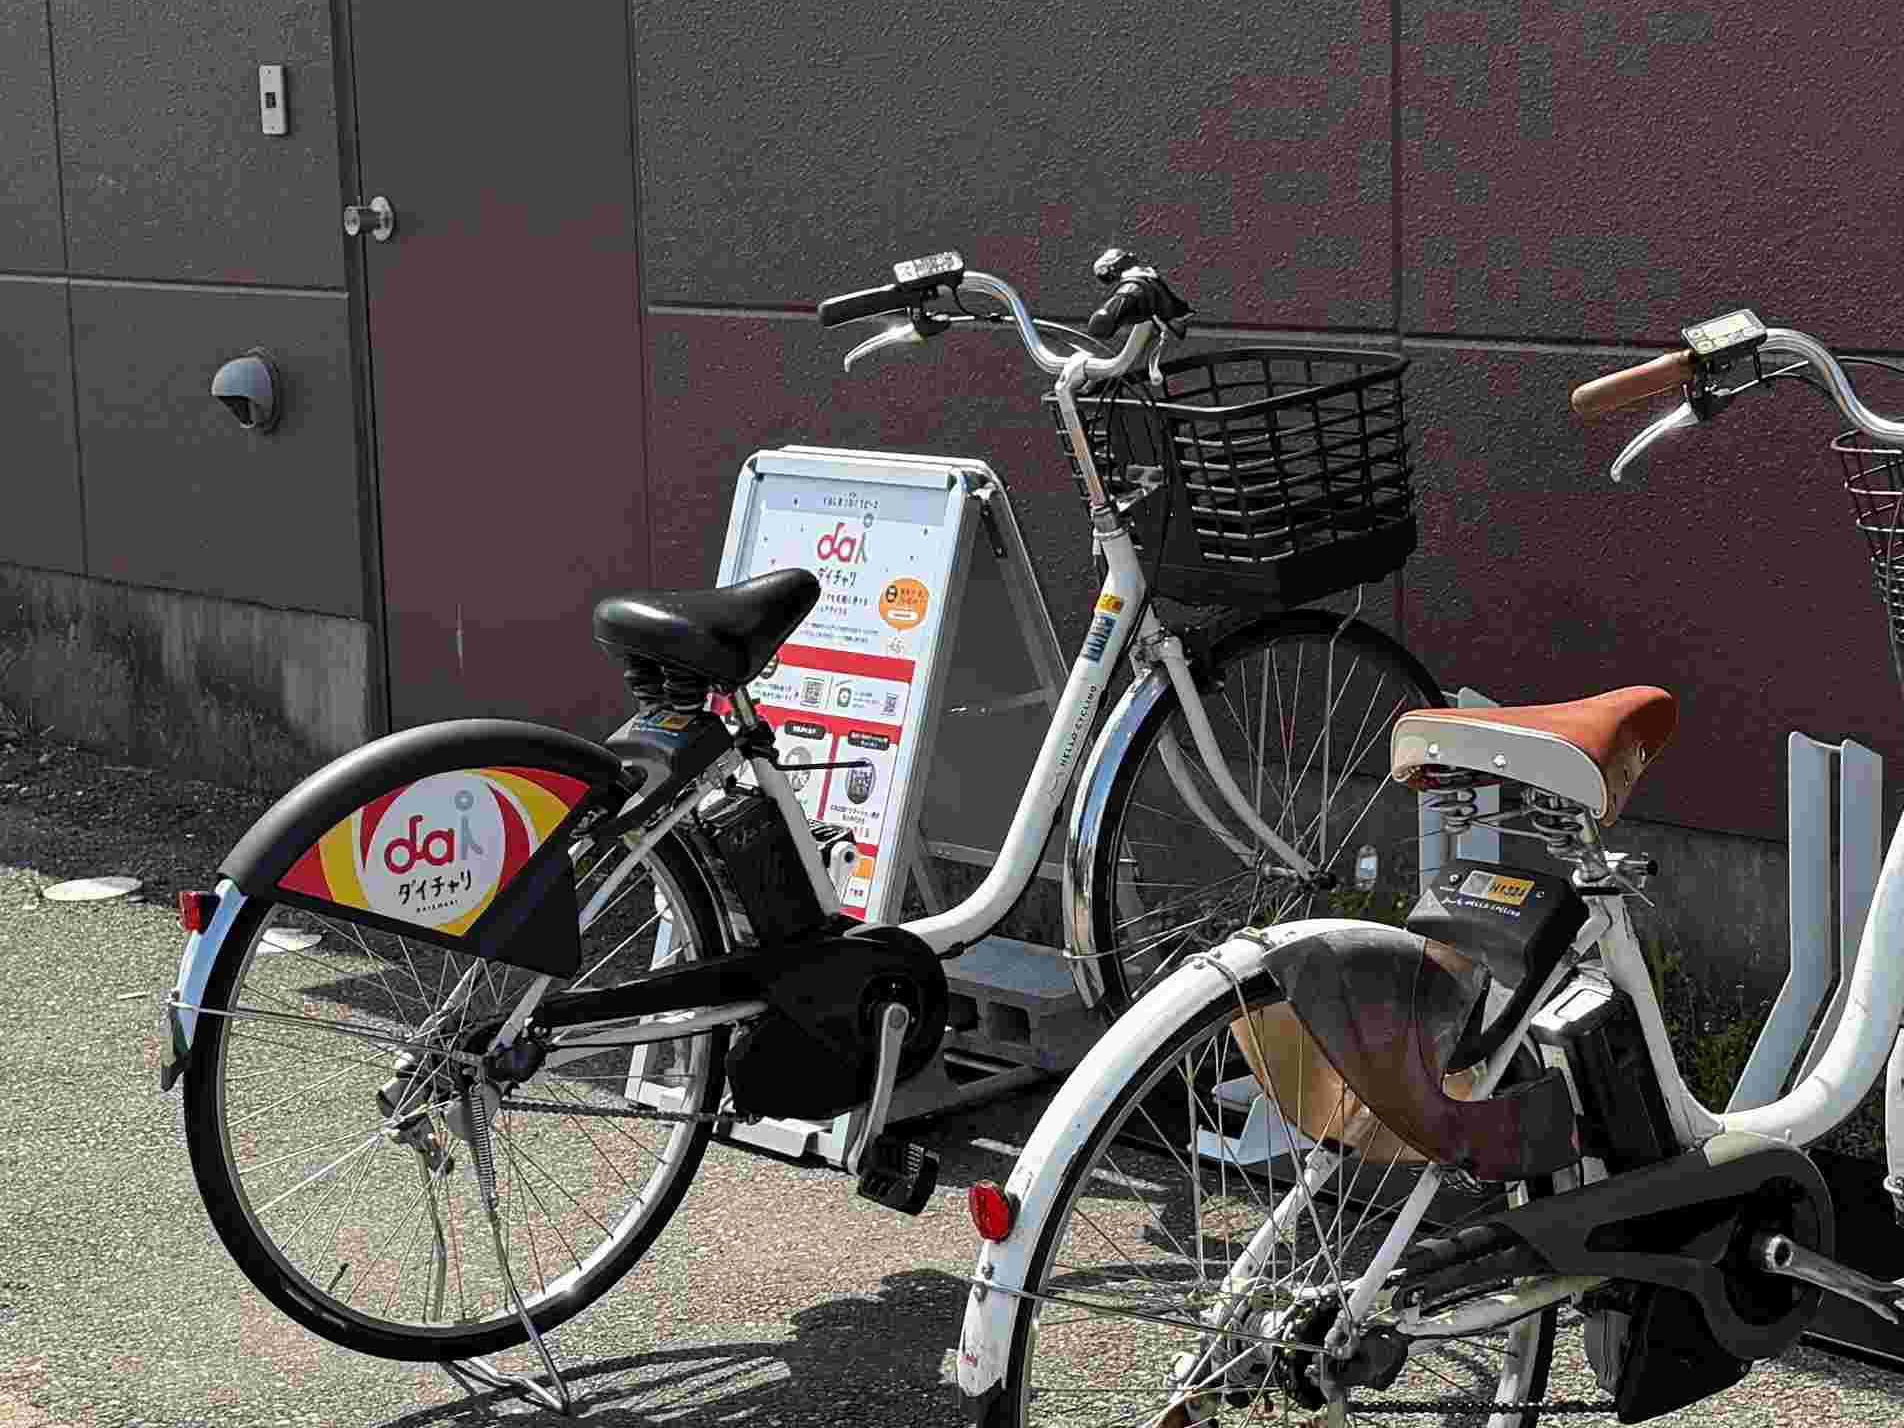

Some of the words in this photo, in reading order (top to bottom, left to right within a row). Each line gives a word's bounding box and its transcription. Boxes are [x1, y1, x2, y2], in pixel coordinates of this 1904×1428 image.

[398, 869, 472, 906] ダイチャリ
